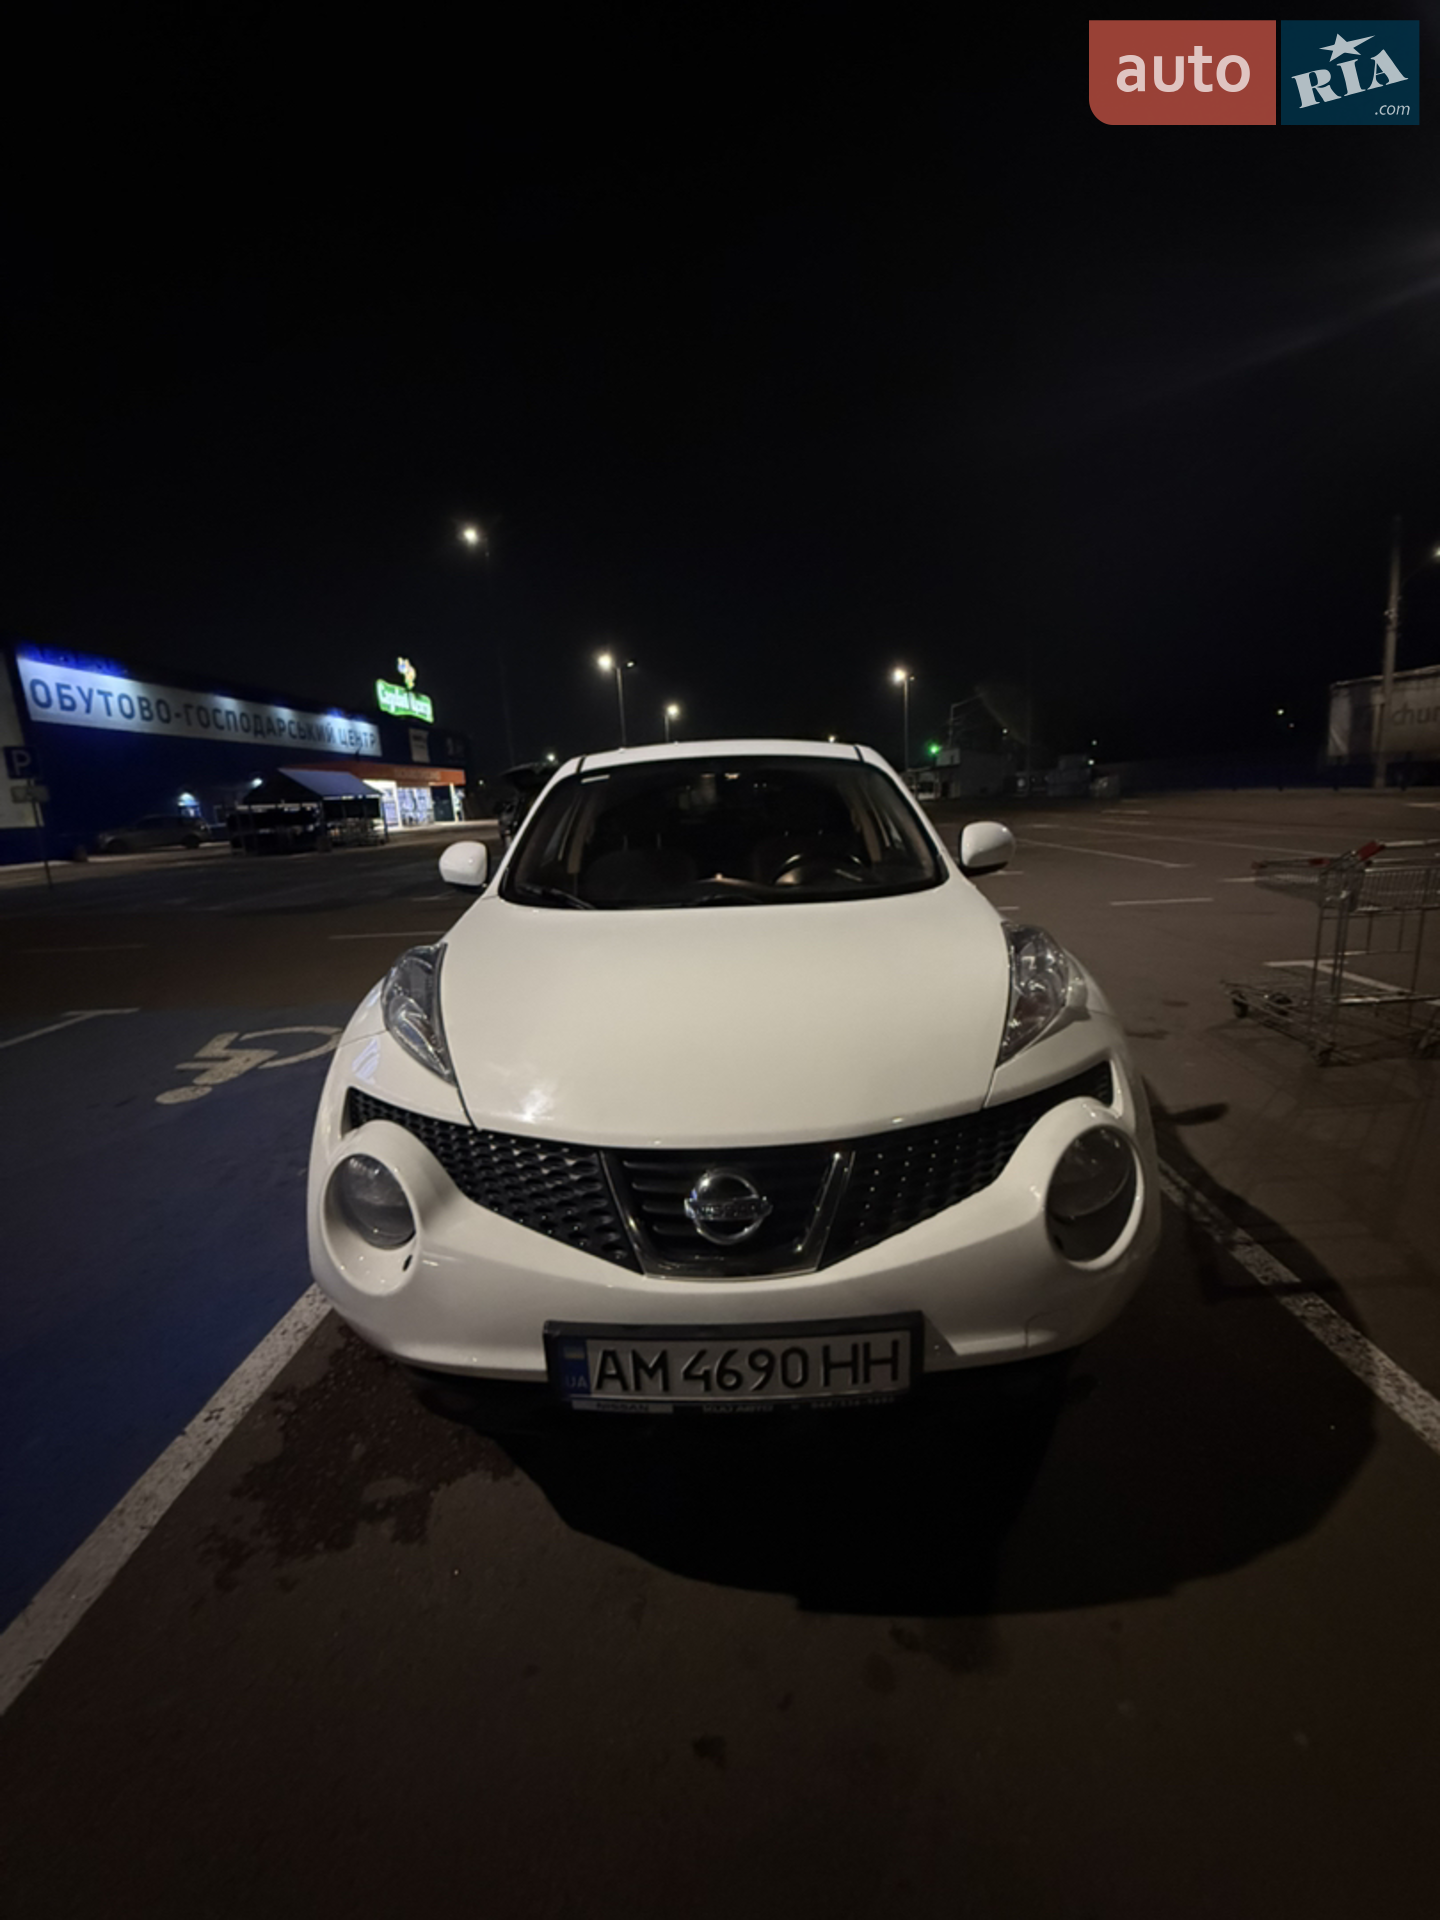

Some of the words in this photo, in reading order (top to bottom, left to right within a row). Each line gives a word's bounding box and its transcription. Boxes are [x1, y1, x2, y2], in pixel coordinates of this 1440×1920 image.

[30, 678, 336, 744] ОБУТОВО-ГОСПОДАРСЬКИЙ
[338, 727, 377, 749] ЦЕНТР
[11, 750, 32, 776] P
[566, 1375, 588, 1389] UA
[596, 1349, 669, 1392] AM
[683, 1348, 808, 1392] 4690
[823, 1340, 899, 1387] HH
